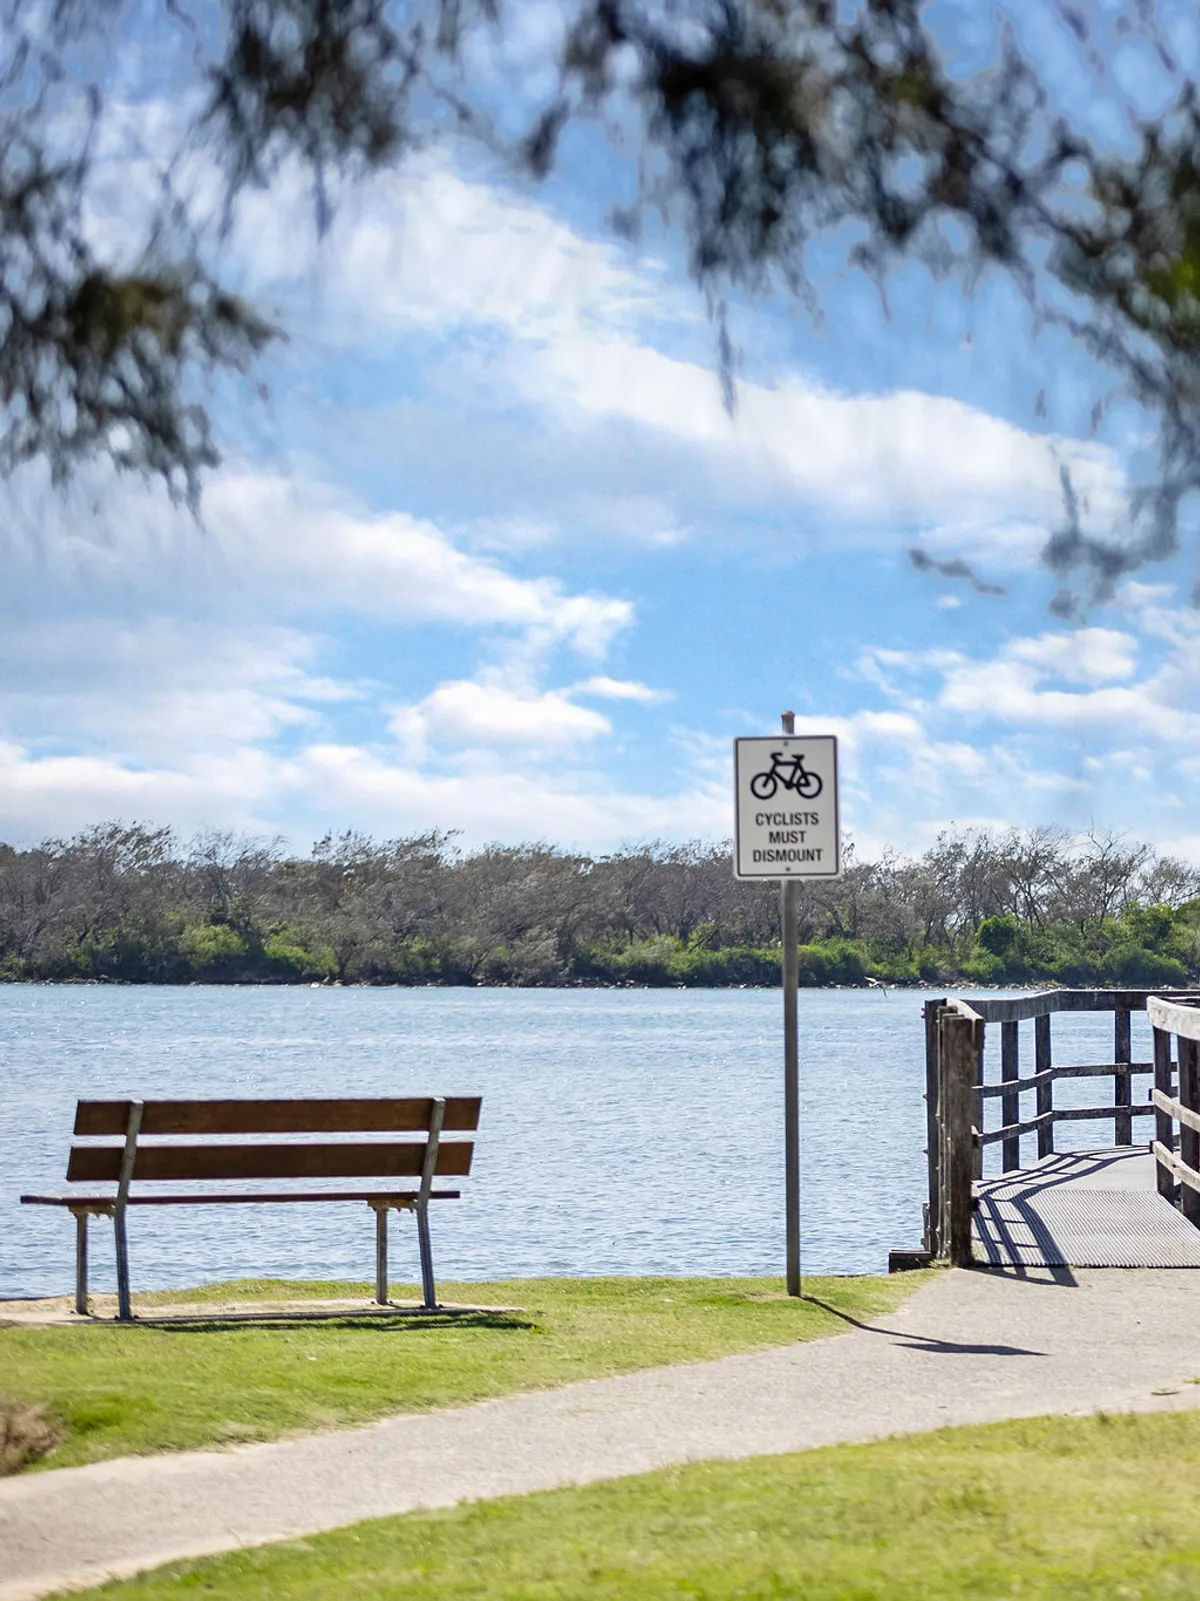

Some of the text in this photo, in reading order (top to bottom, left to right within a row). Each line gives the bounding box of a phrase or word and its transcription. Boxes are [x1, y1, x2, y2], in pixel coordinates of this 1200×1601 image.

[755, 812, 819, 826] CYCLISTS
[768, 830, 806, 844] MUST
[752, 848, 822, 862] DISMOUNT
